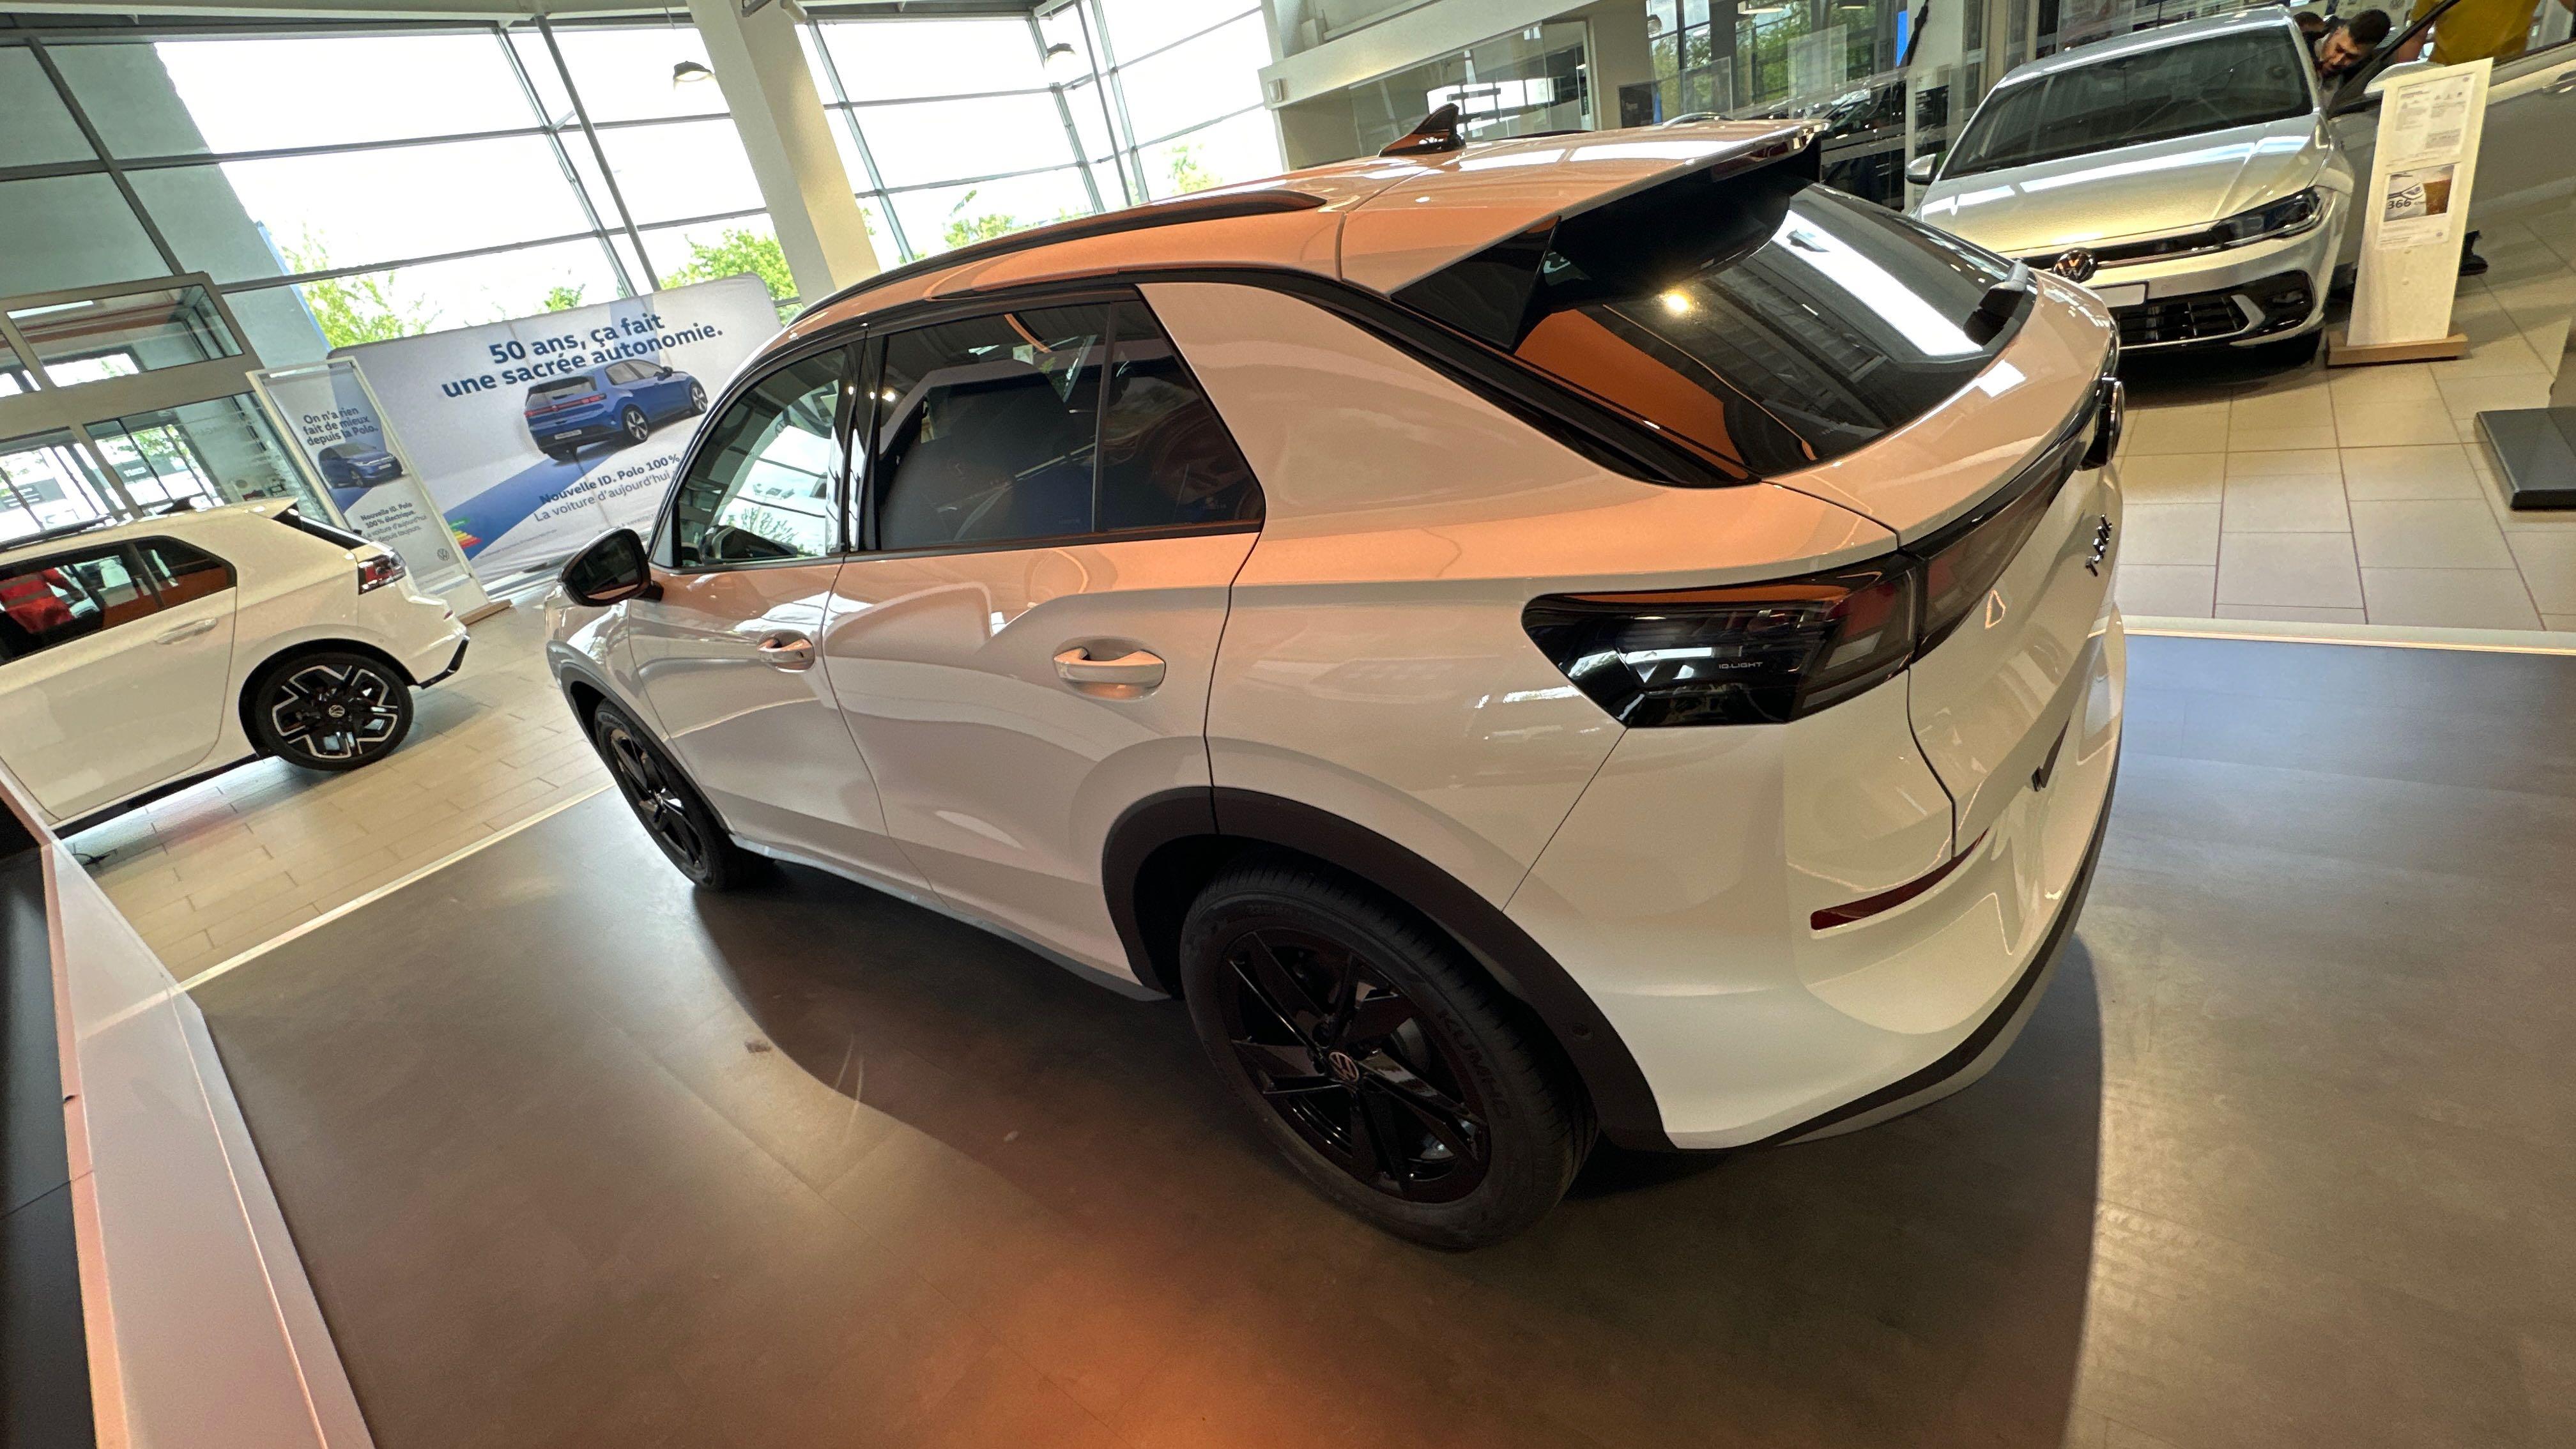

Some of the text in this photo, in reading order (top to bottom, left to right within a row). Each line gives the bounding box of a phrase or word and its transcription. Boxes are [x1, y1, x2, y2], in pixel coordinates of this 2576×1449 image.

[488, 312, 665, 364] 50 ans, ça fait
[441, 323, 723, 397] une sacrée autonomie.
[303, 407, 358, 424] On n'a rien
[303, 416, 371, 434] fait de mieux
[307, 431, 342, 446] depuis
[341, 429, 352, 438] la
[539, 481, 597, 503] Nouvelle
[597, 475, 617, 486] ID.
[617, 466, 645, 480] Polo
[533, 470, 671, 522] La voiture d'aujourd'hui
[360, 509, 389, 521] Nouvelle
[371, 526, 392, 536] voiture
[378, 533, 398, 542] depuis
[1436, 1008, 1512, 1119] KUMHO
